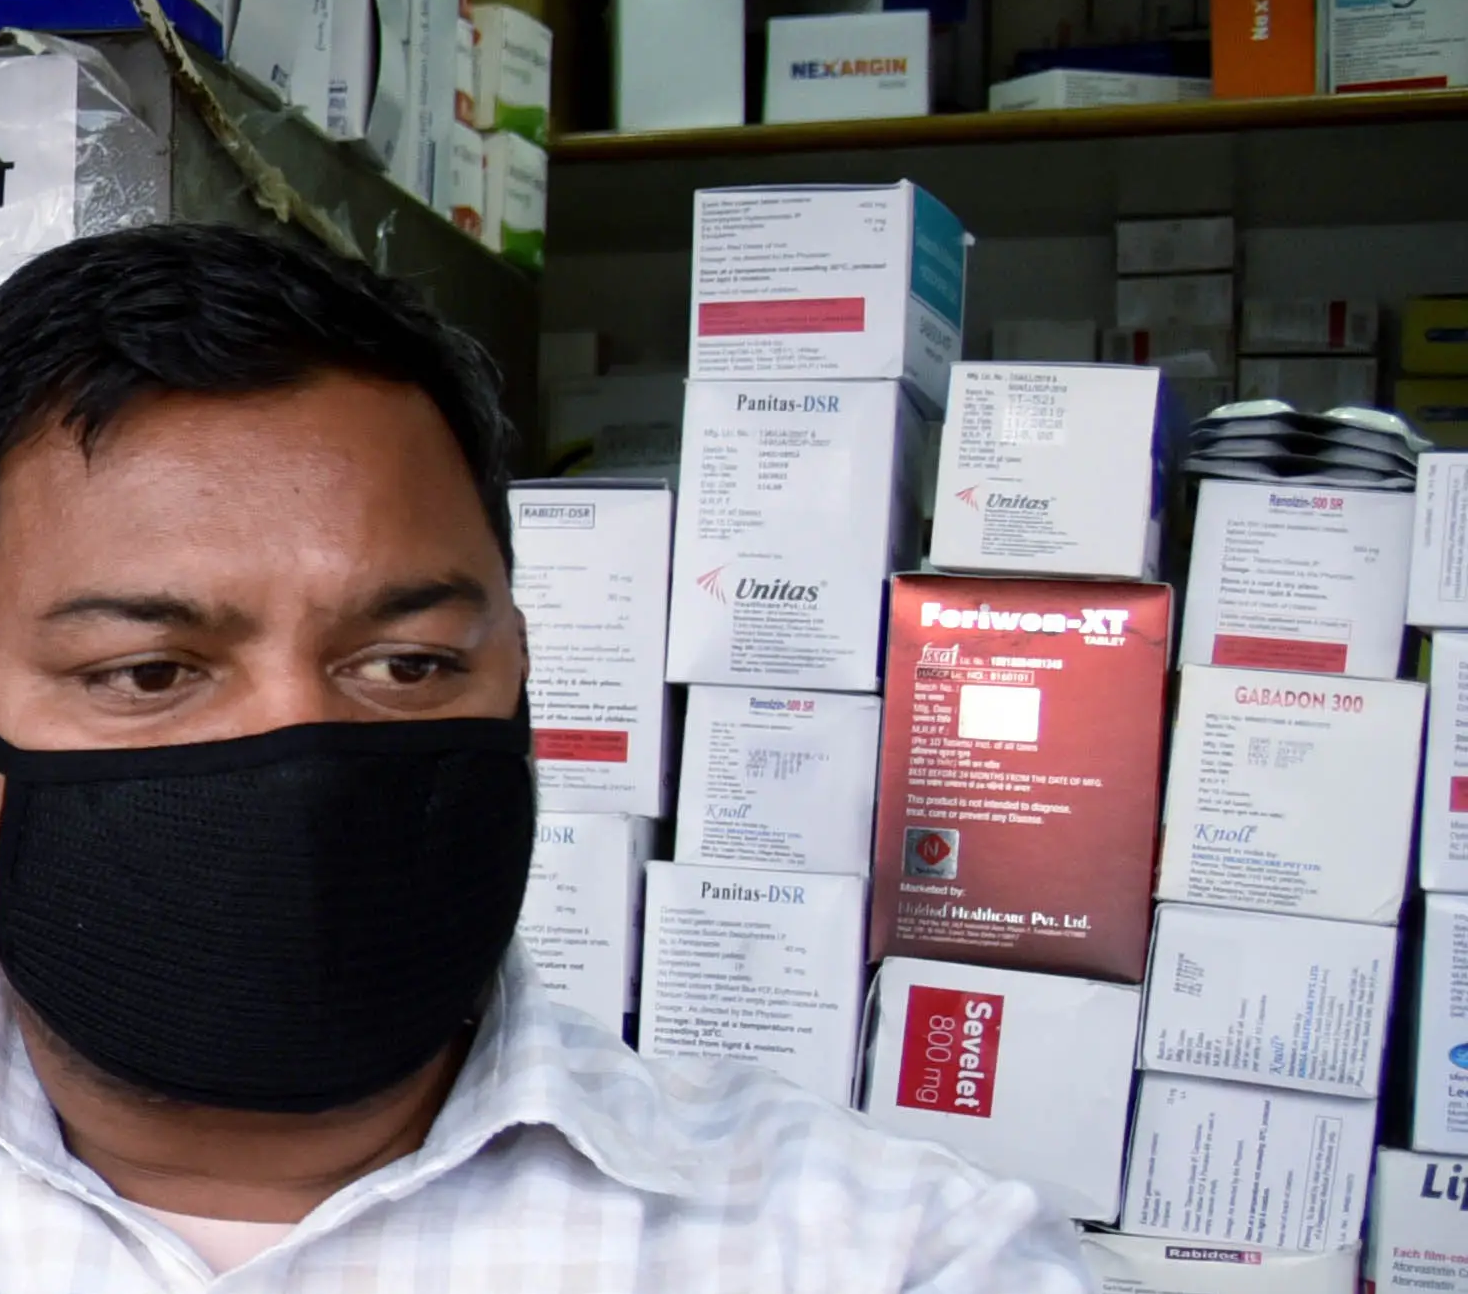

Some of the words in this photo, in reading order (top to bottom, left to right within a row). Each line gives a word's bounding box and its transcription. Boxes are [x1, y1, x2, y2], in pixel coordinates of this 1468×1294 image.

[790, 57, 908, 80] NEXARGIN
[736, 393, 840, 413] Panitas-DSR
[986, 493, 1050, 510] Unitas
[735, 578, 820, 602] Unitas
[1084, 636, 1126, 646] TABLET
[1235, 686, 1325, 710] GABADON
[1332, 694, 1364, 713] 300
[926, 796, 957, 807] product
[984, 800, 1020, 810] intended
[1194, 823, 1257, 843] Knoll
[701, 881, 805, 904] Panitas-DSR
[900, 883, 947, 895] Marketed
[951, 905, 1026, 924] Healthcare
[1031, 912, 1059, 927] Pvt.
[1064, 914, 1091, 929] Ltd.
[925, 1013, 956, 1064] 800
[953, 998, 993, 1109] Sevelet
[915, 1067, 943, 1105] mg
[1168, 1248, 1240, 1262] Rabidoc
[1393, 1247, 1422, 1259] Each
